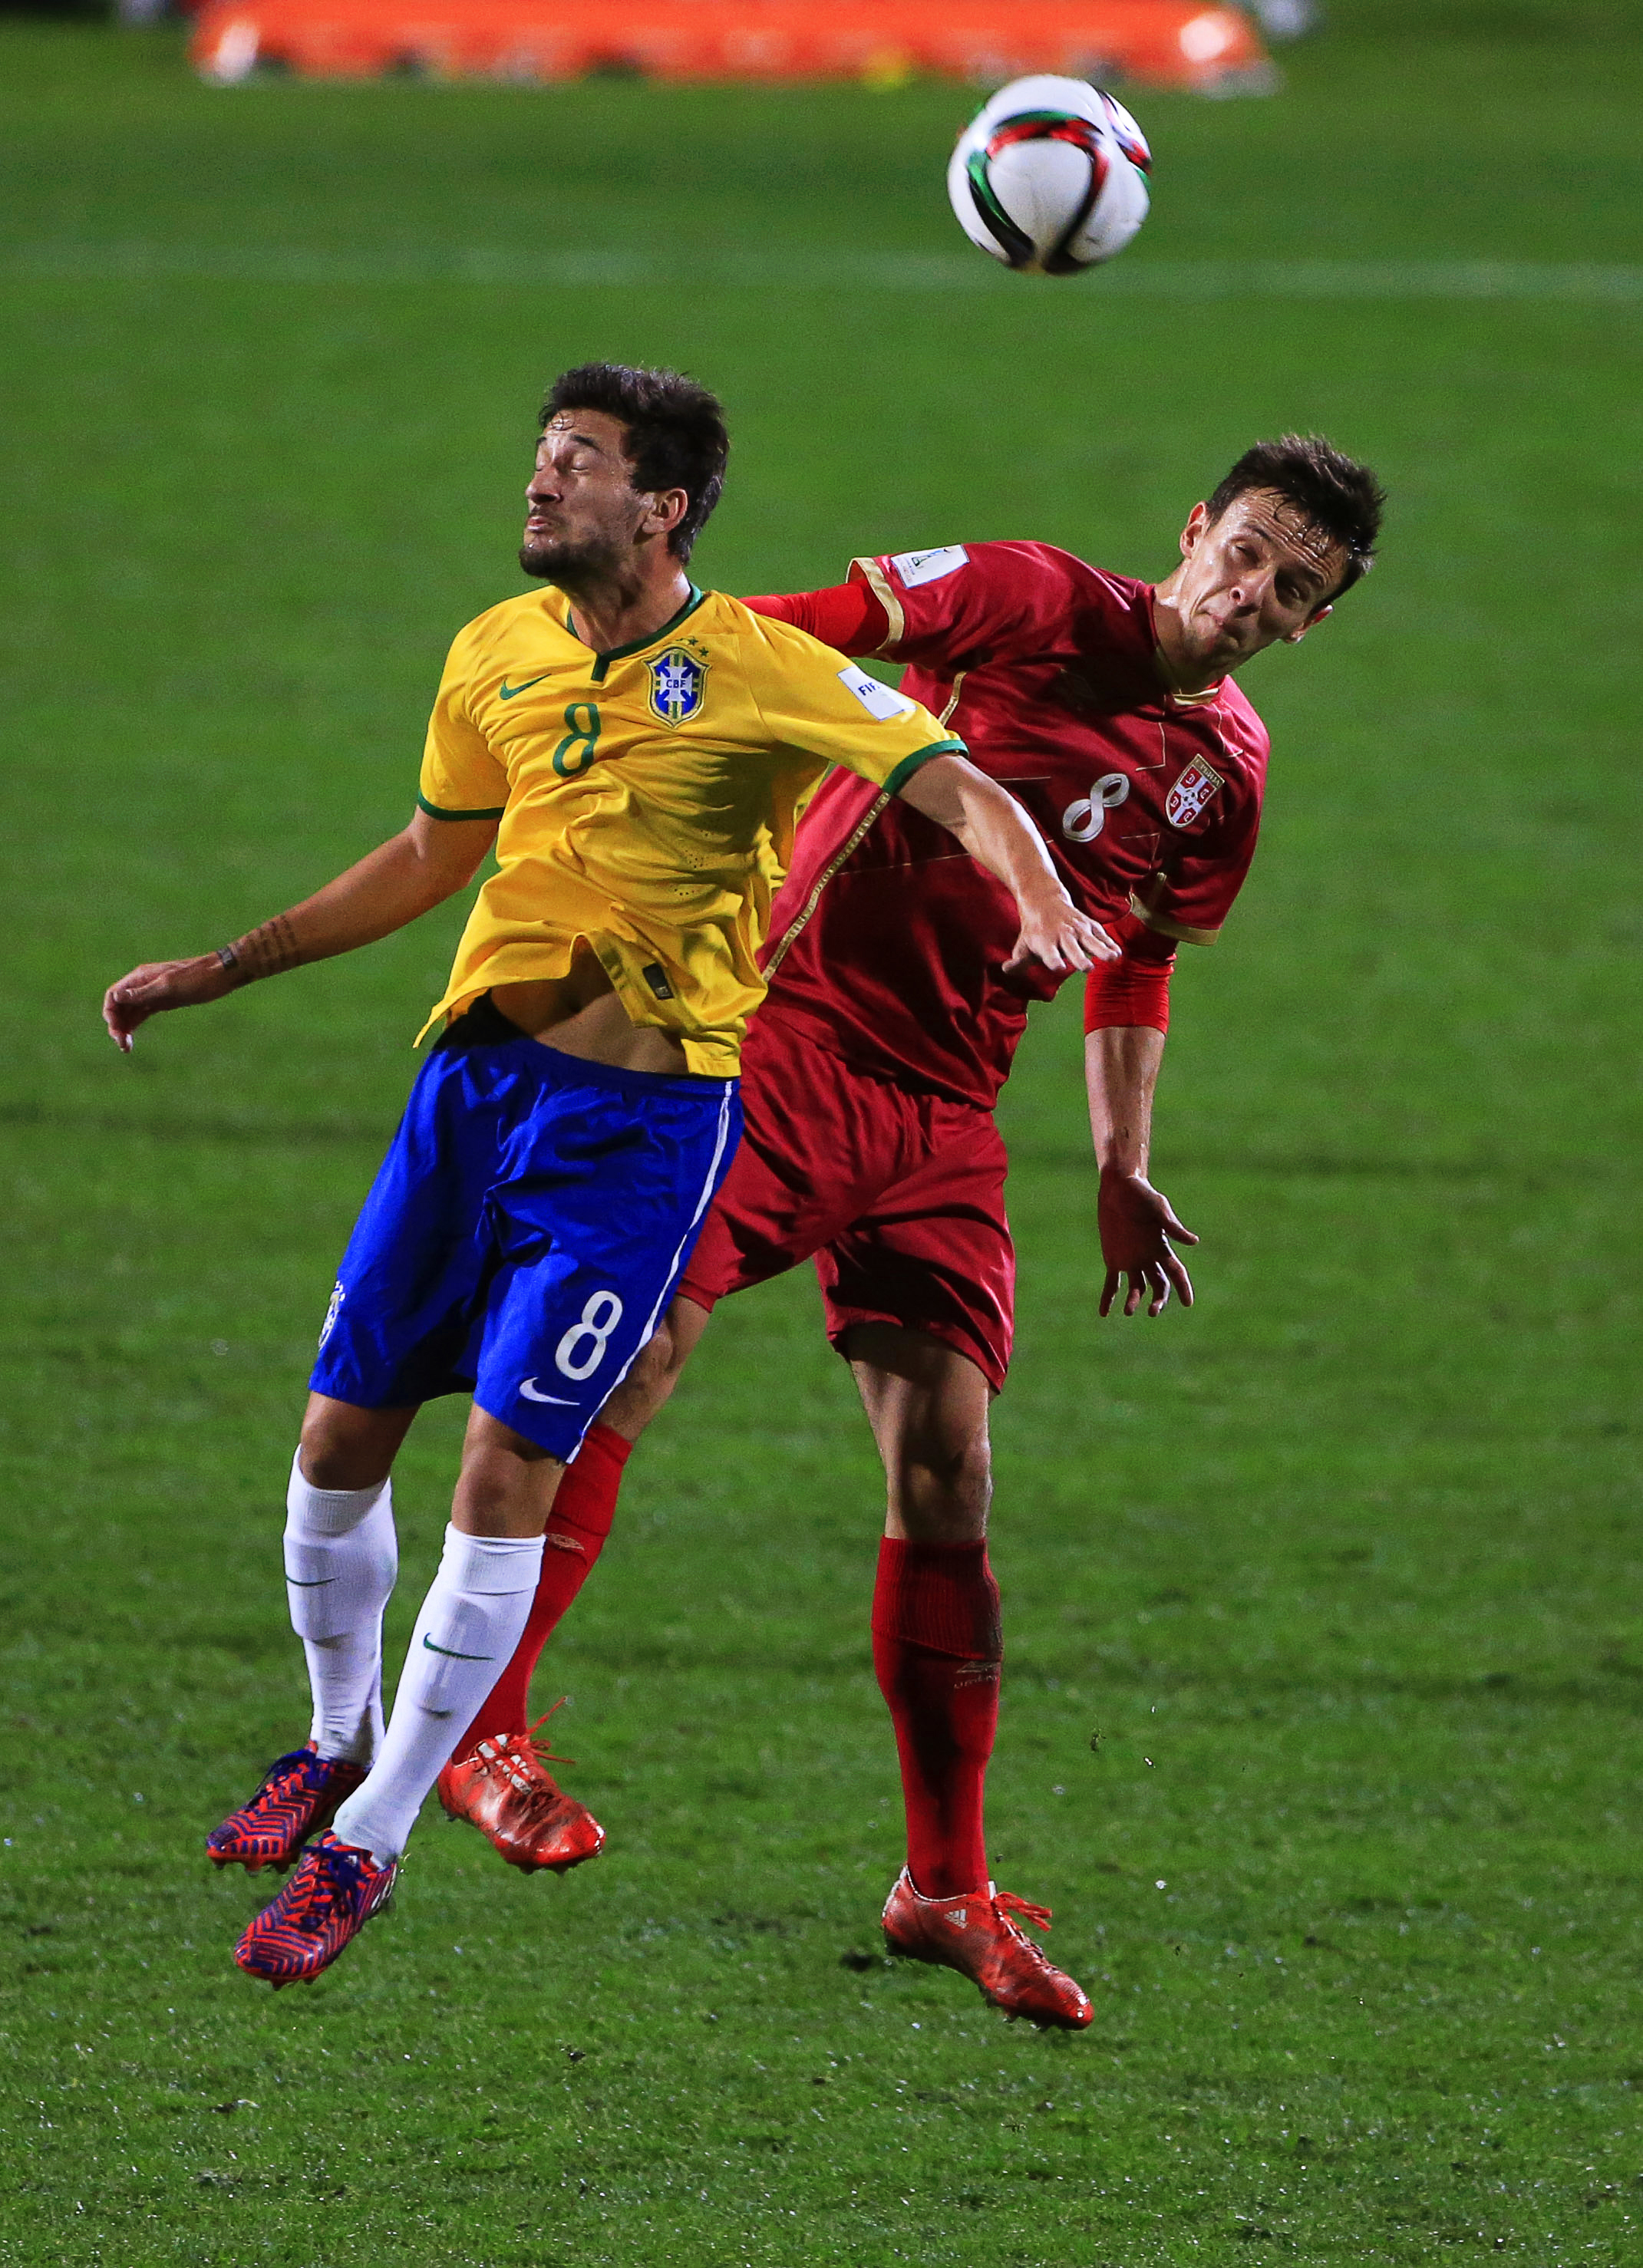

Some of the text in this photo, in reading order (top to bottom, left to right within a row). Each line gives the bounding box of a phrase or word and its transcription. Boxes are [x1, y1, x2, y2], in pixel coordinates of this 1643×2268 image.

[666, 679, 686, 688] CBF
[857, 682, 880, 696] FIF
[552, 702, 602, 778] 8
[1062, 773, 1130, 842] 8
[555, 1290, 623, 1380] 8
